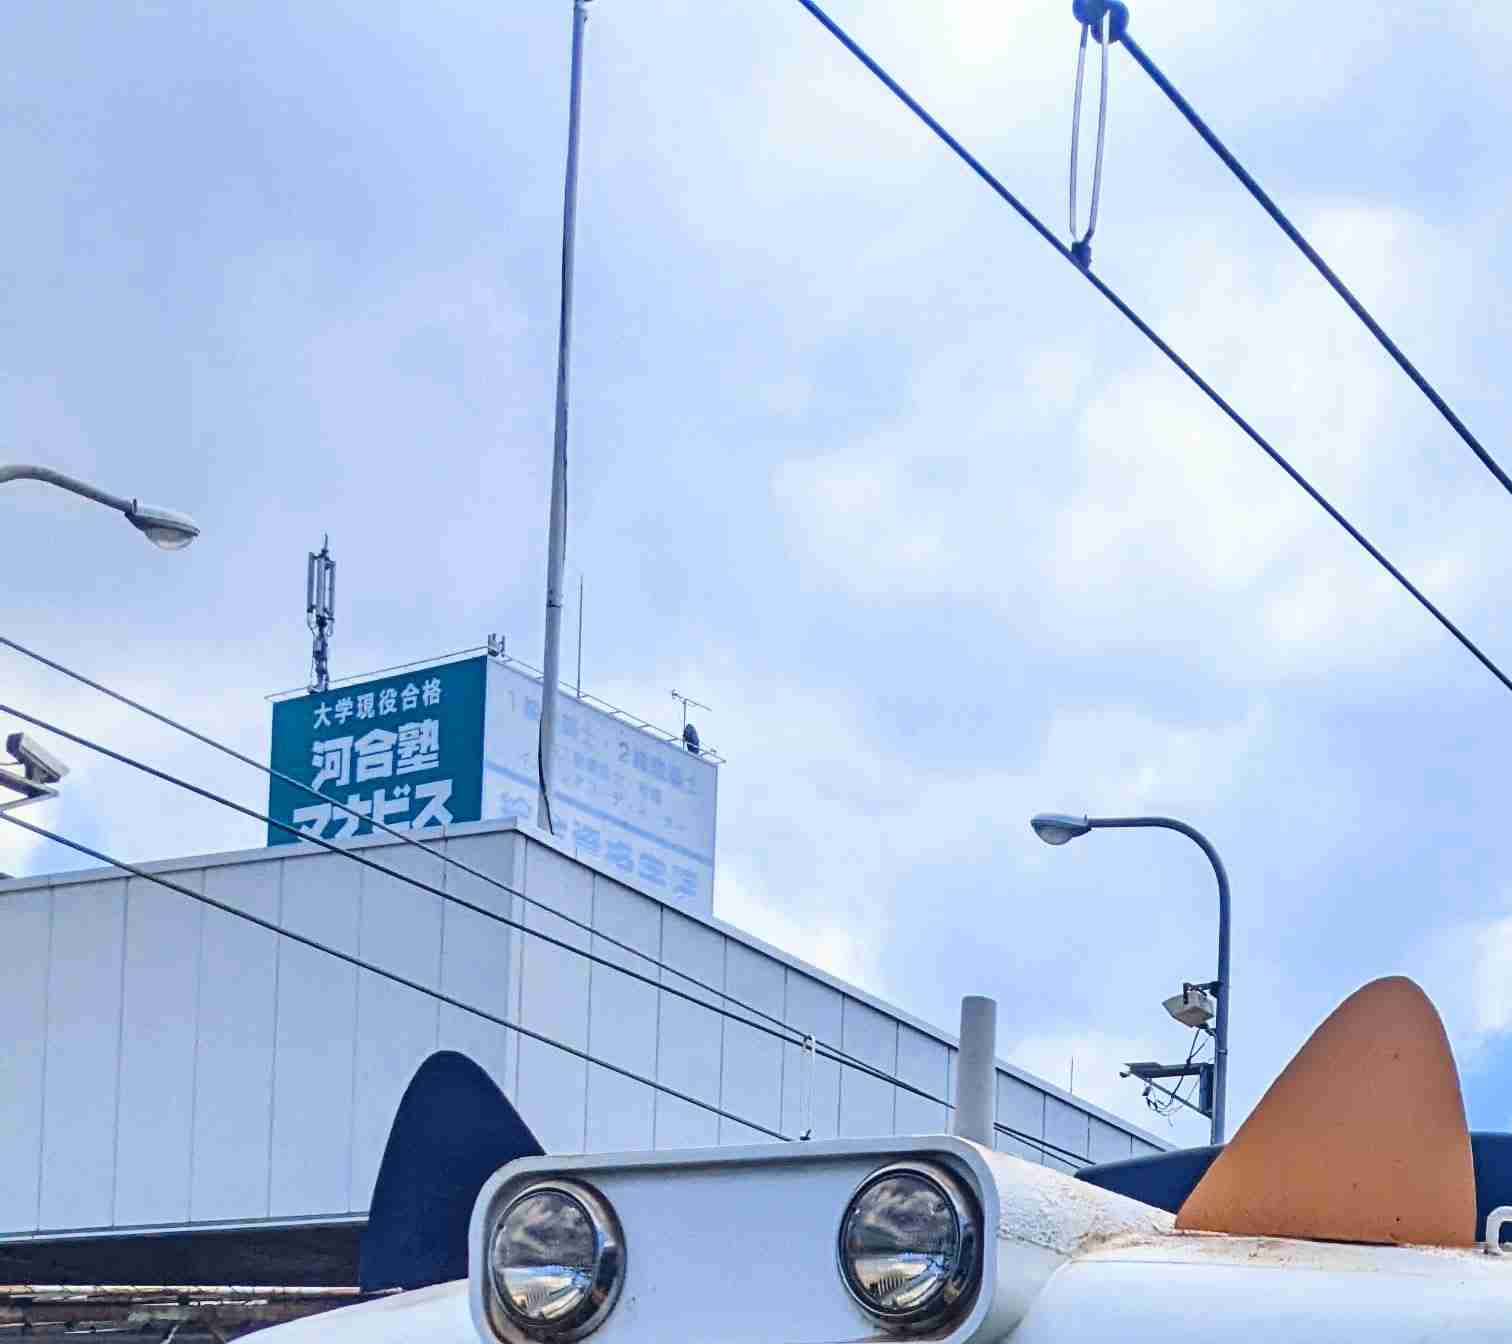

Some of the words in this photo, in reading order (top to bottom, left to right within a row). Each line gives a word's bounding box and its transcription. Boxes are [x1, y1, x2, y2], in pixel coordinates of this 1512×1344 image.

[313, 678, 442, 729] 大学現役合格
[312, 718, 440, 793] 河合塾
[292, 778, 453, 840] マナビス
